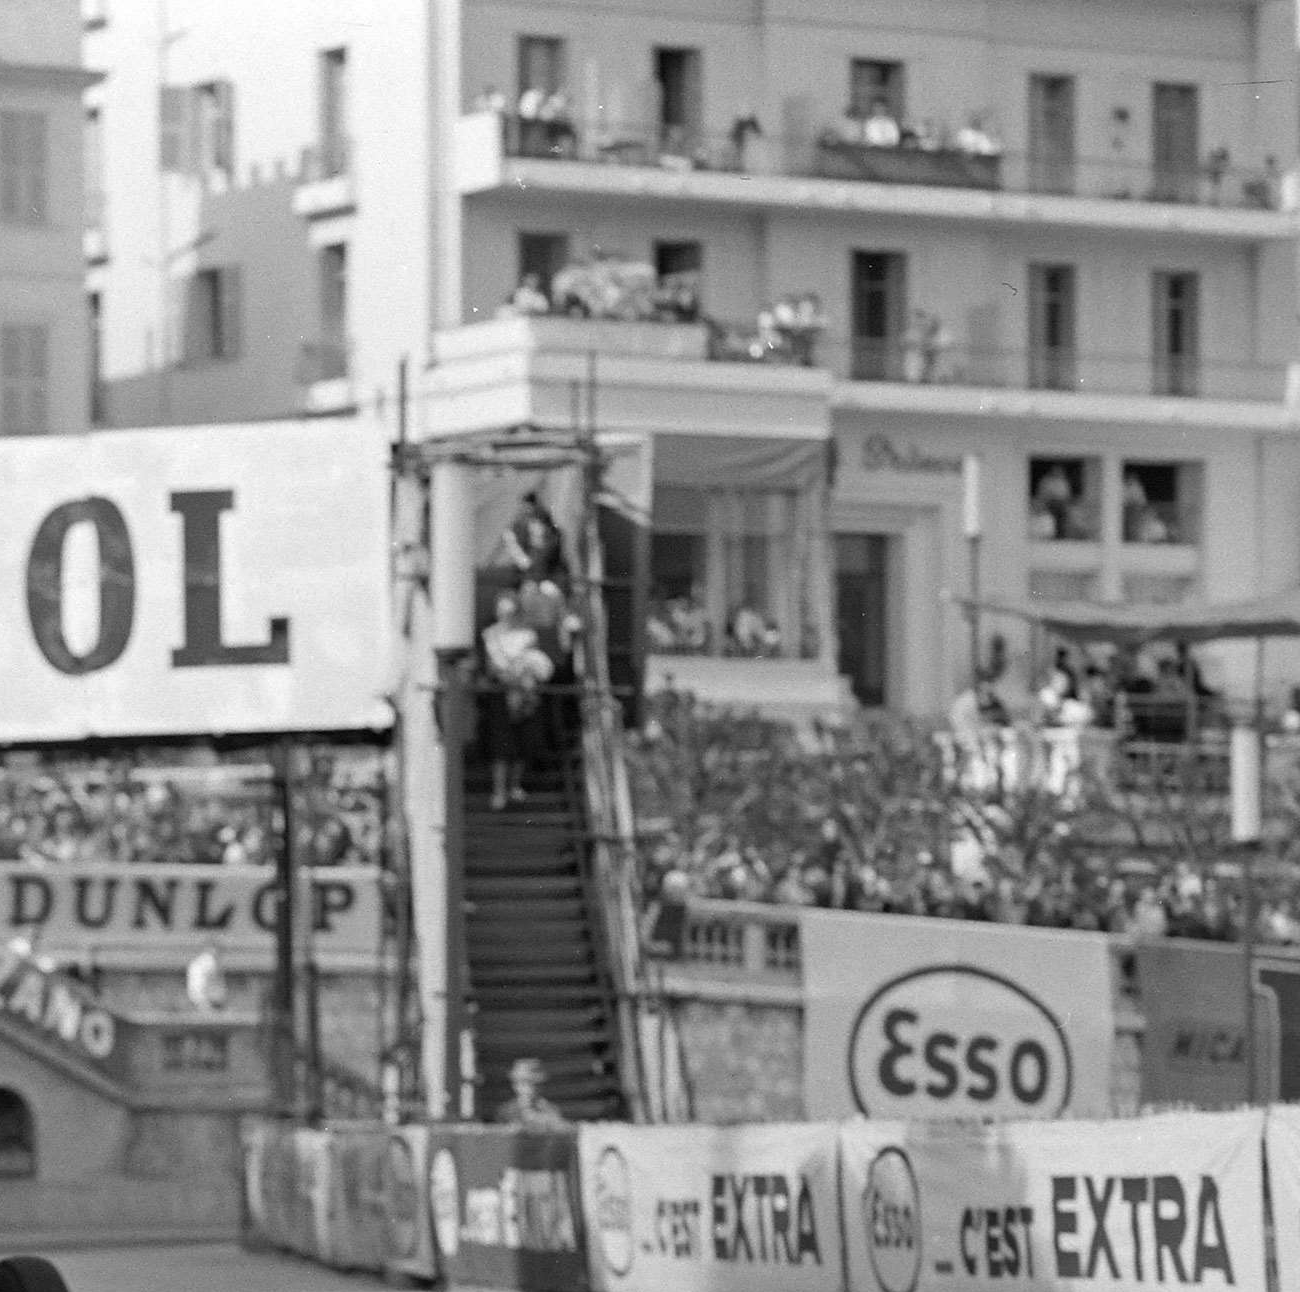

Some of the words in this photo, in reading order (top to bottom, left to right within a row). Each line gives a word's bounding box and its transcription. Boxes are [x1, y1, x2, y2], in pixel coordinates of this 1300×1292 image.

[7, 873, 356, 934] DUNLOP
[711, 1173, 823, 1267] EXTRA
[1051, 1174, 1236, 1285] EXTRA
